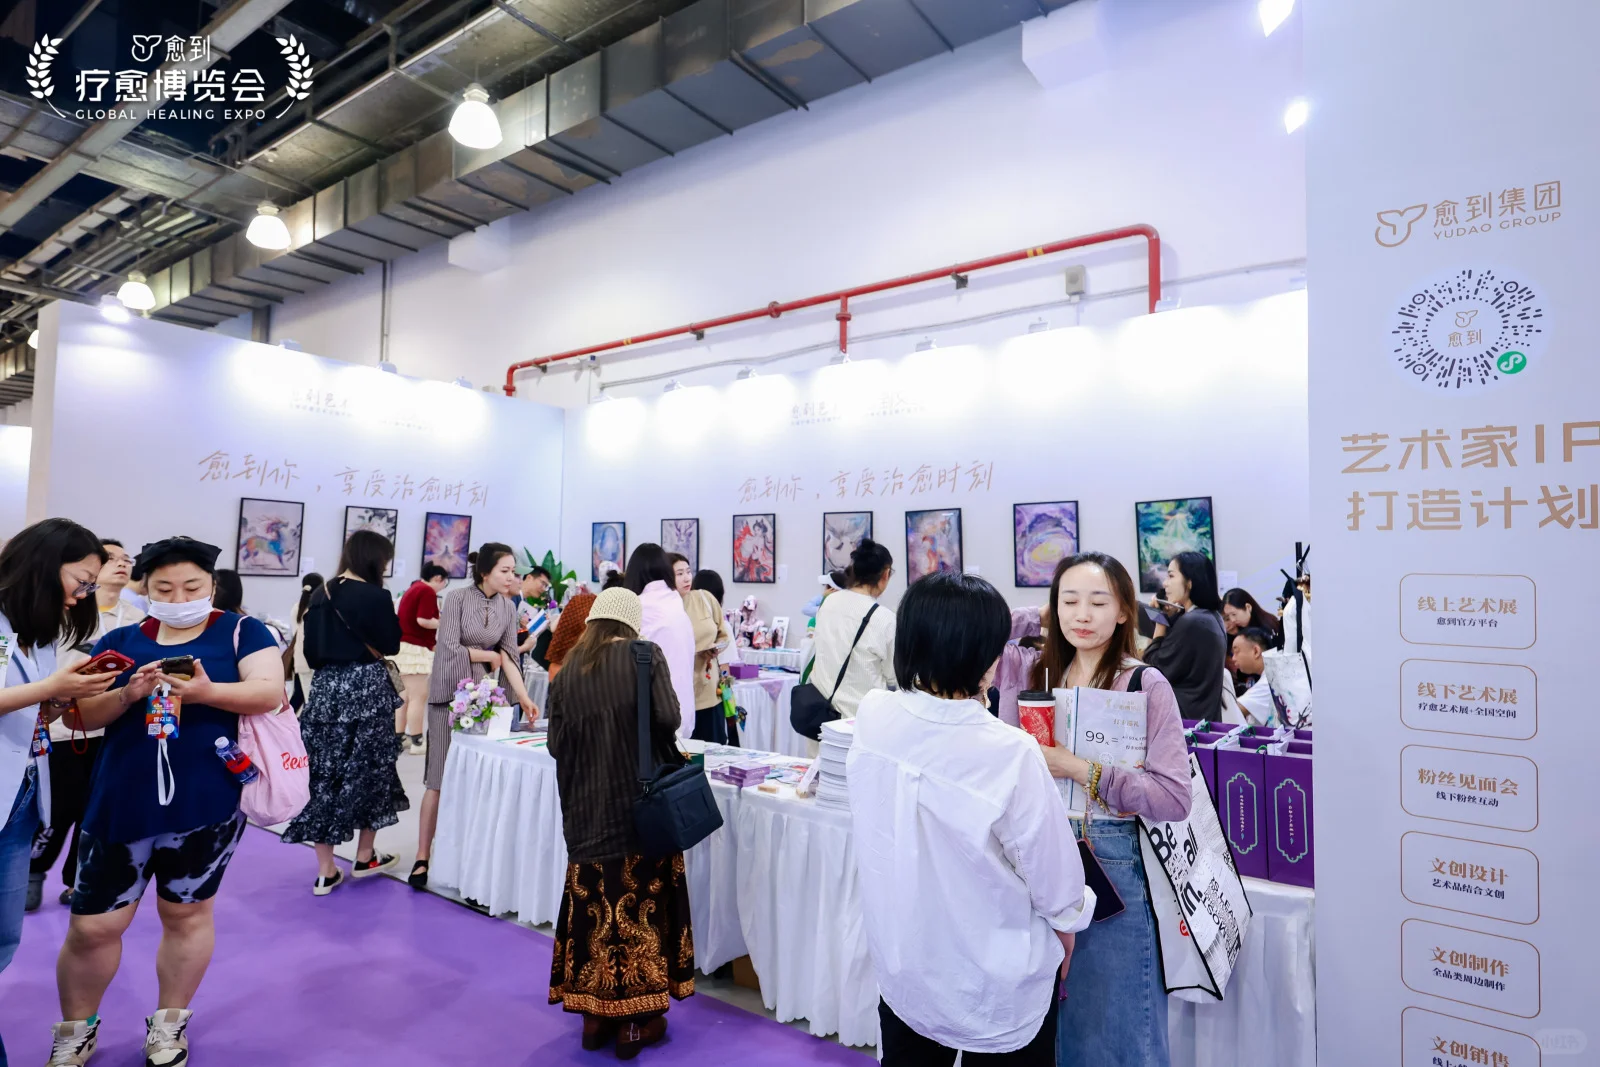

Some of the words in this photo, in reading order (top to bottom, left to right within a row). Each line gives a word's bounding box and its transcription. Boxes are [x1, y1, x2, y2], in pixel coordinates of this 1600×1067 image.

[1433, 180, 1561, 228] 愈到集团
[1434, 223, 1492, 240] YUDAO
[1499, 211, 1562, 230] GROUP
[1447, 329, 1482, 348] 愈到
[1347, 484, 1600, 531] 打造计划
[1417, 596, 1518, 615] 线上艺术展
[1437, 616, 1498, 628] 愈到官方平台
[1417, 681, 1518, 705] 线下艺术展
[1418, 702, 1517, 719] 疗愈艺术展+全国空间
[1417, 768, 1519, 796] 粉丝见面会
[1436, 790, 1499, 808] 线下粉丝互动
[1429, 857, 1509, 886] 文创设计
[1432, 878, 1506, 900] 艺术品结合文创
[1429, 946, 1510, 978] 文创制作
[1432, 967, 1506, 992] 全品类周边制作
[1430, 1035, 1509, 1067] 文创销售
